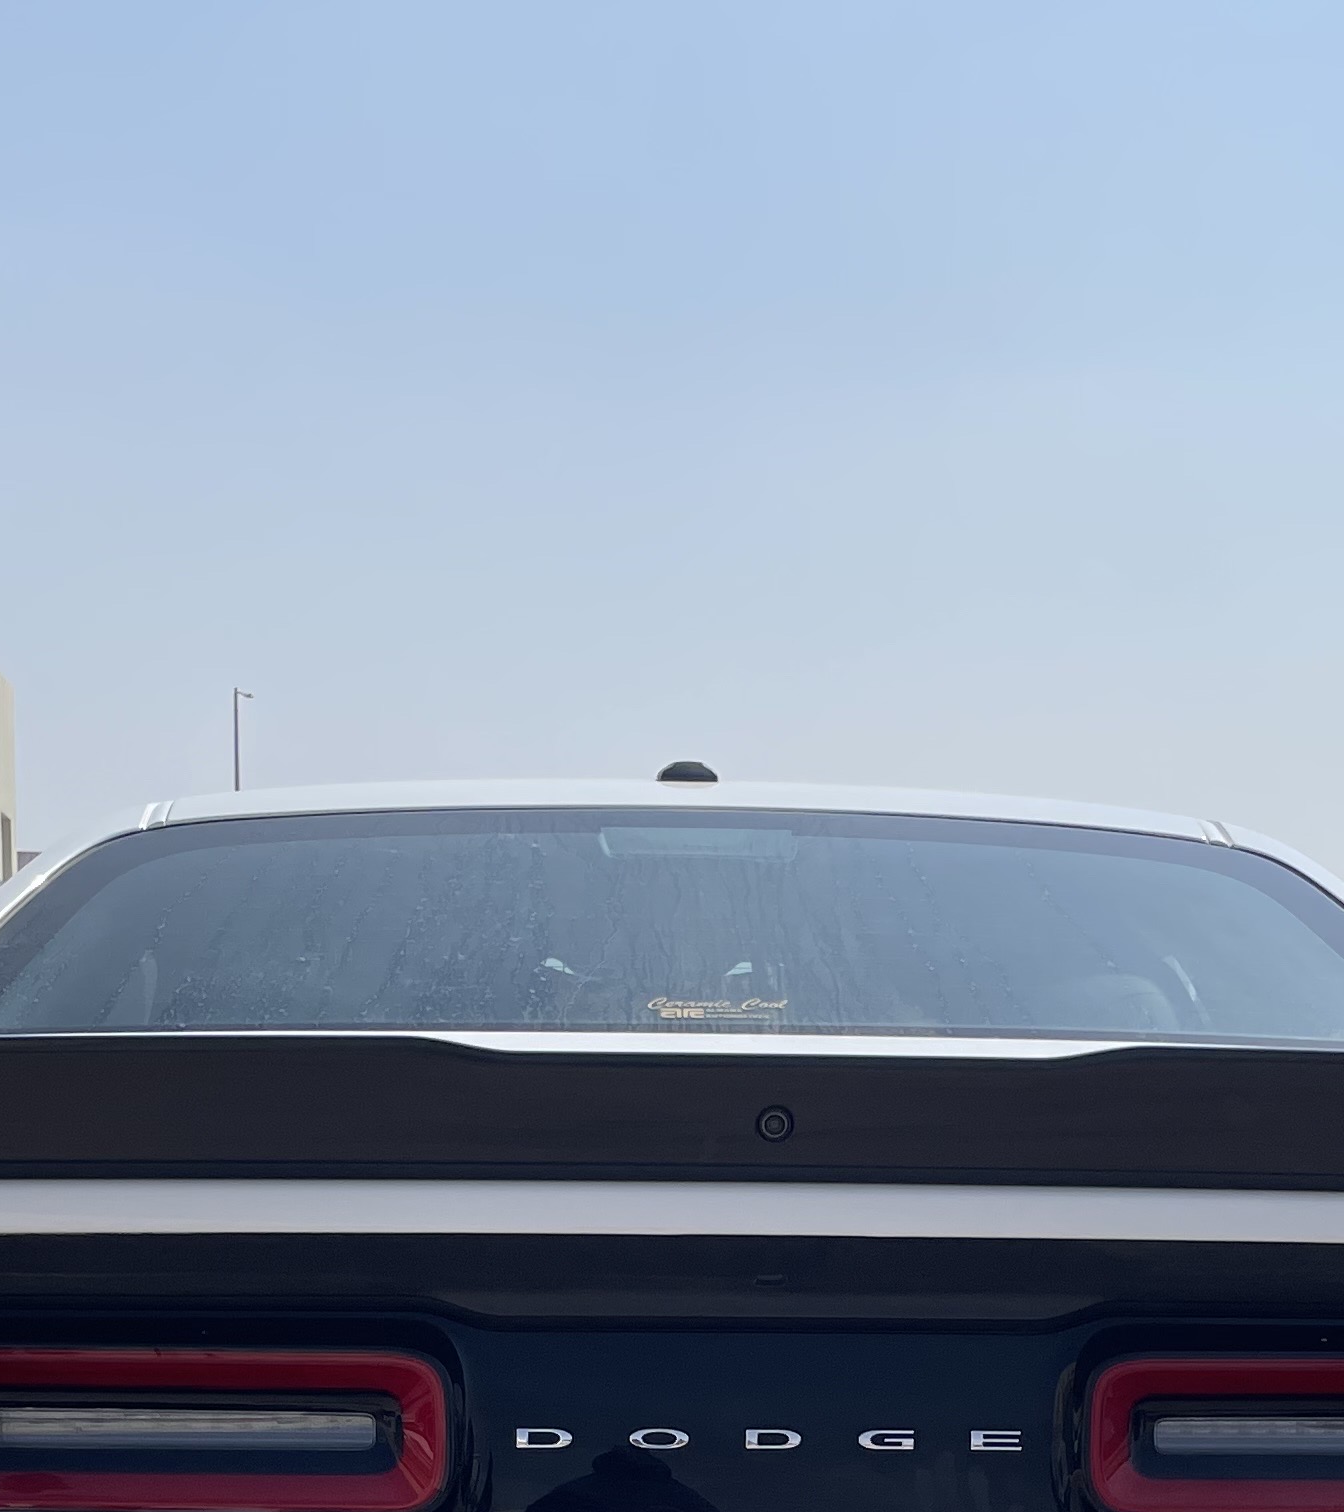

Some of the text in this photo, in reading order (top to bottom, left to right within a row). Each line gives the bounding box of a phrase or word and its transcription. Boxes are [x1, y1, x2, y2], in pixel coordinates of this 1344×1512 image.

[647, 997, 788, 1011] Ceramic Cool
[516, 1428, 1023, 1451] DODGE
